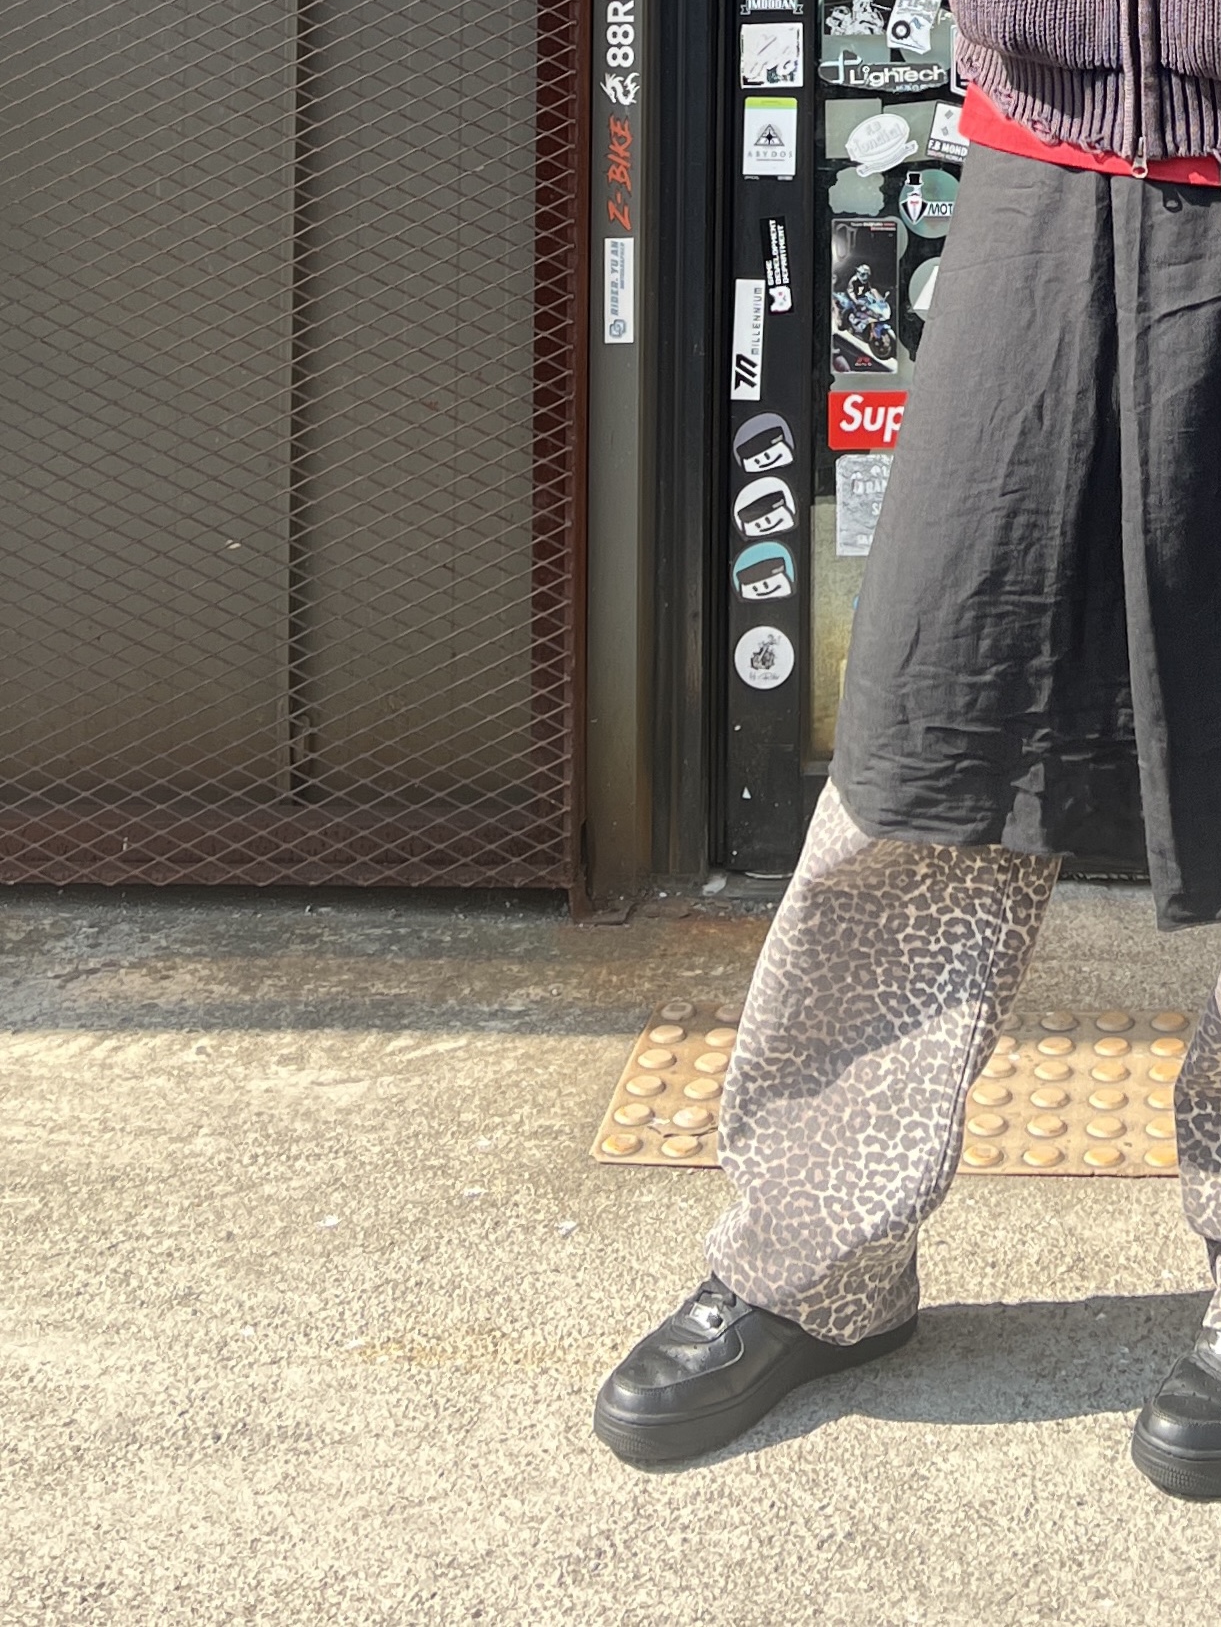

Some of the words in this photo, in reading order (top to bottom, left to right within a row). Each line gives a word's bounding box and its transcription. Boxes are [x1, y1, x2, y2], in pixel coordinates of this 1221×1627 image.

[608, 114, 631, 231] Z-BIKE
[751, 286, 763, 355] MILLENNIUM
[839, 394, 904, 443] Sup
